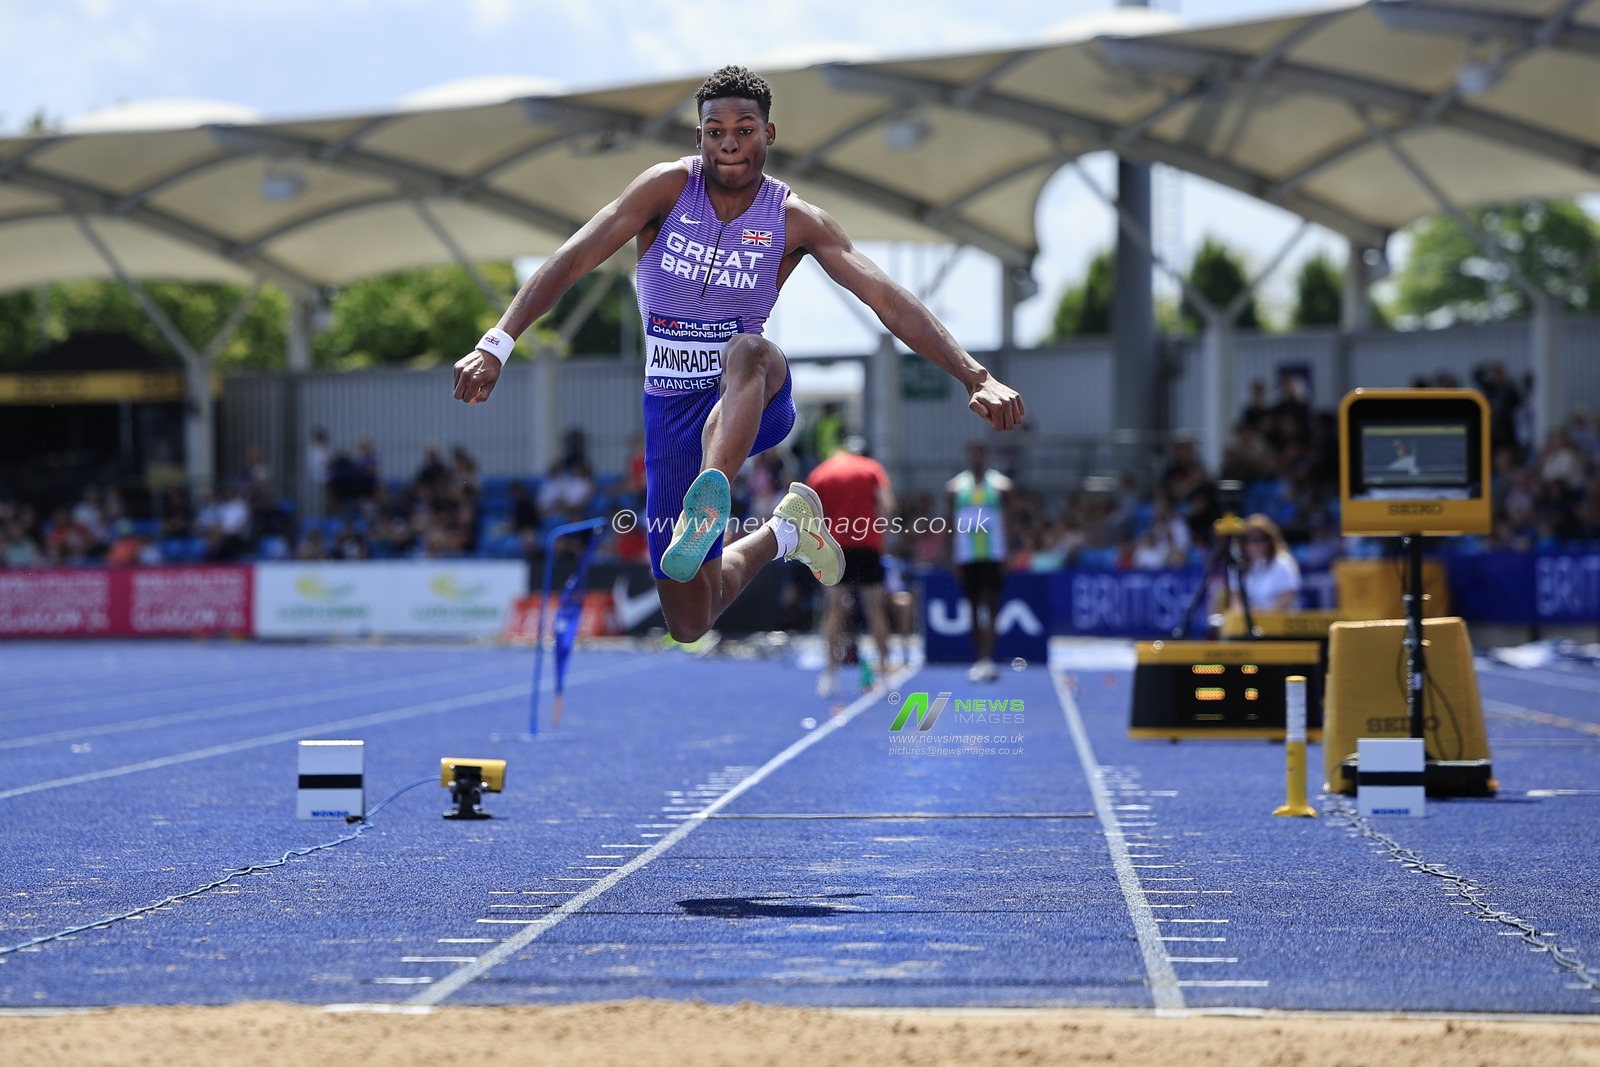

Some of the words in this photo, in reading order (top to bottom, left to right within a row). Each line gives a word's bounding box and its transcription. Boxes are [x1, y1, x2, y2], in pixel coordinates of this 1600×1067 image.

[666, 231, 763, 269] GREAT
[660, 252, 758, 289] BRITAIN
[652, 316, 666, 328] UK
[669, 319, 738, 332] ATHLETICS
[652, 325, 738, 338] CHAMPIONSHIPS
[1388, 504, 1444, 516] SEIKO
[1366, 716, 1440, 733] SEIO
